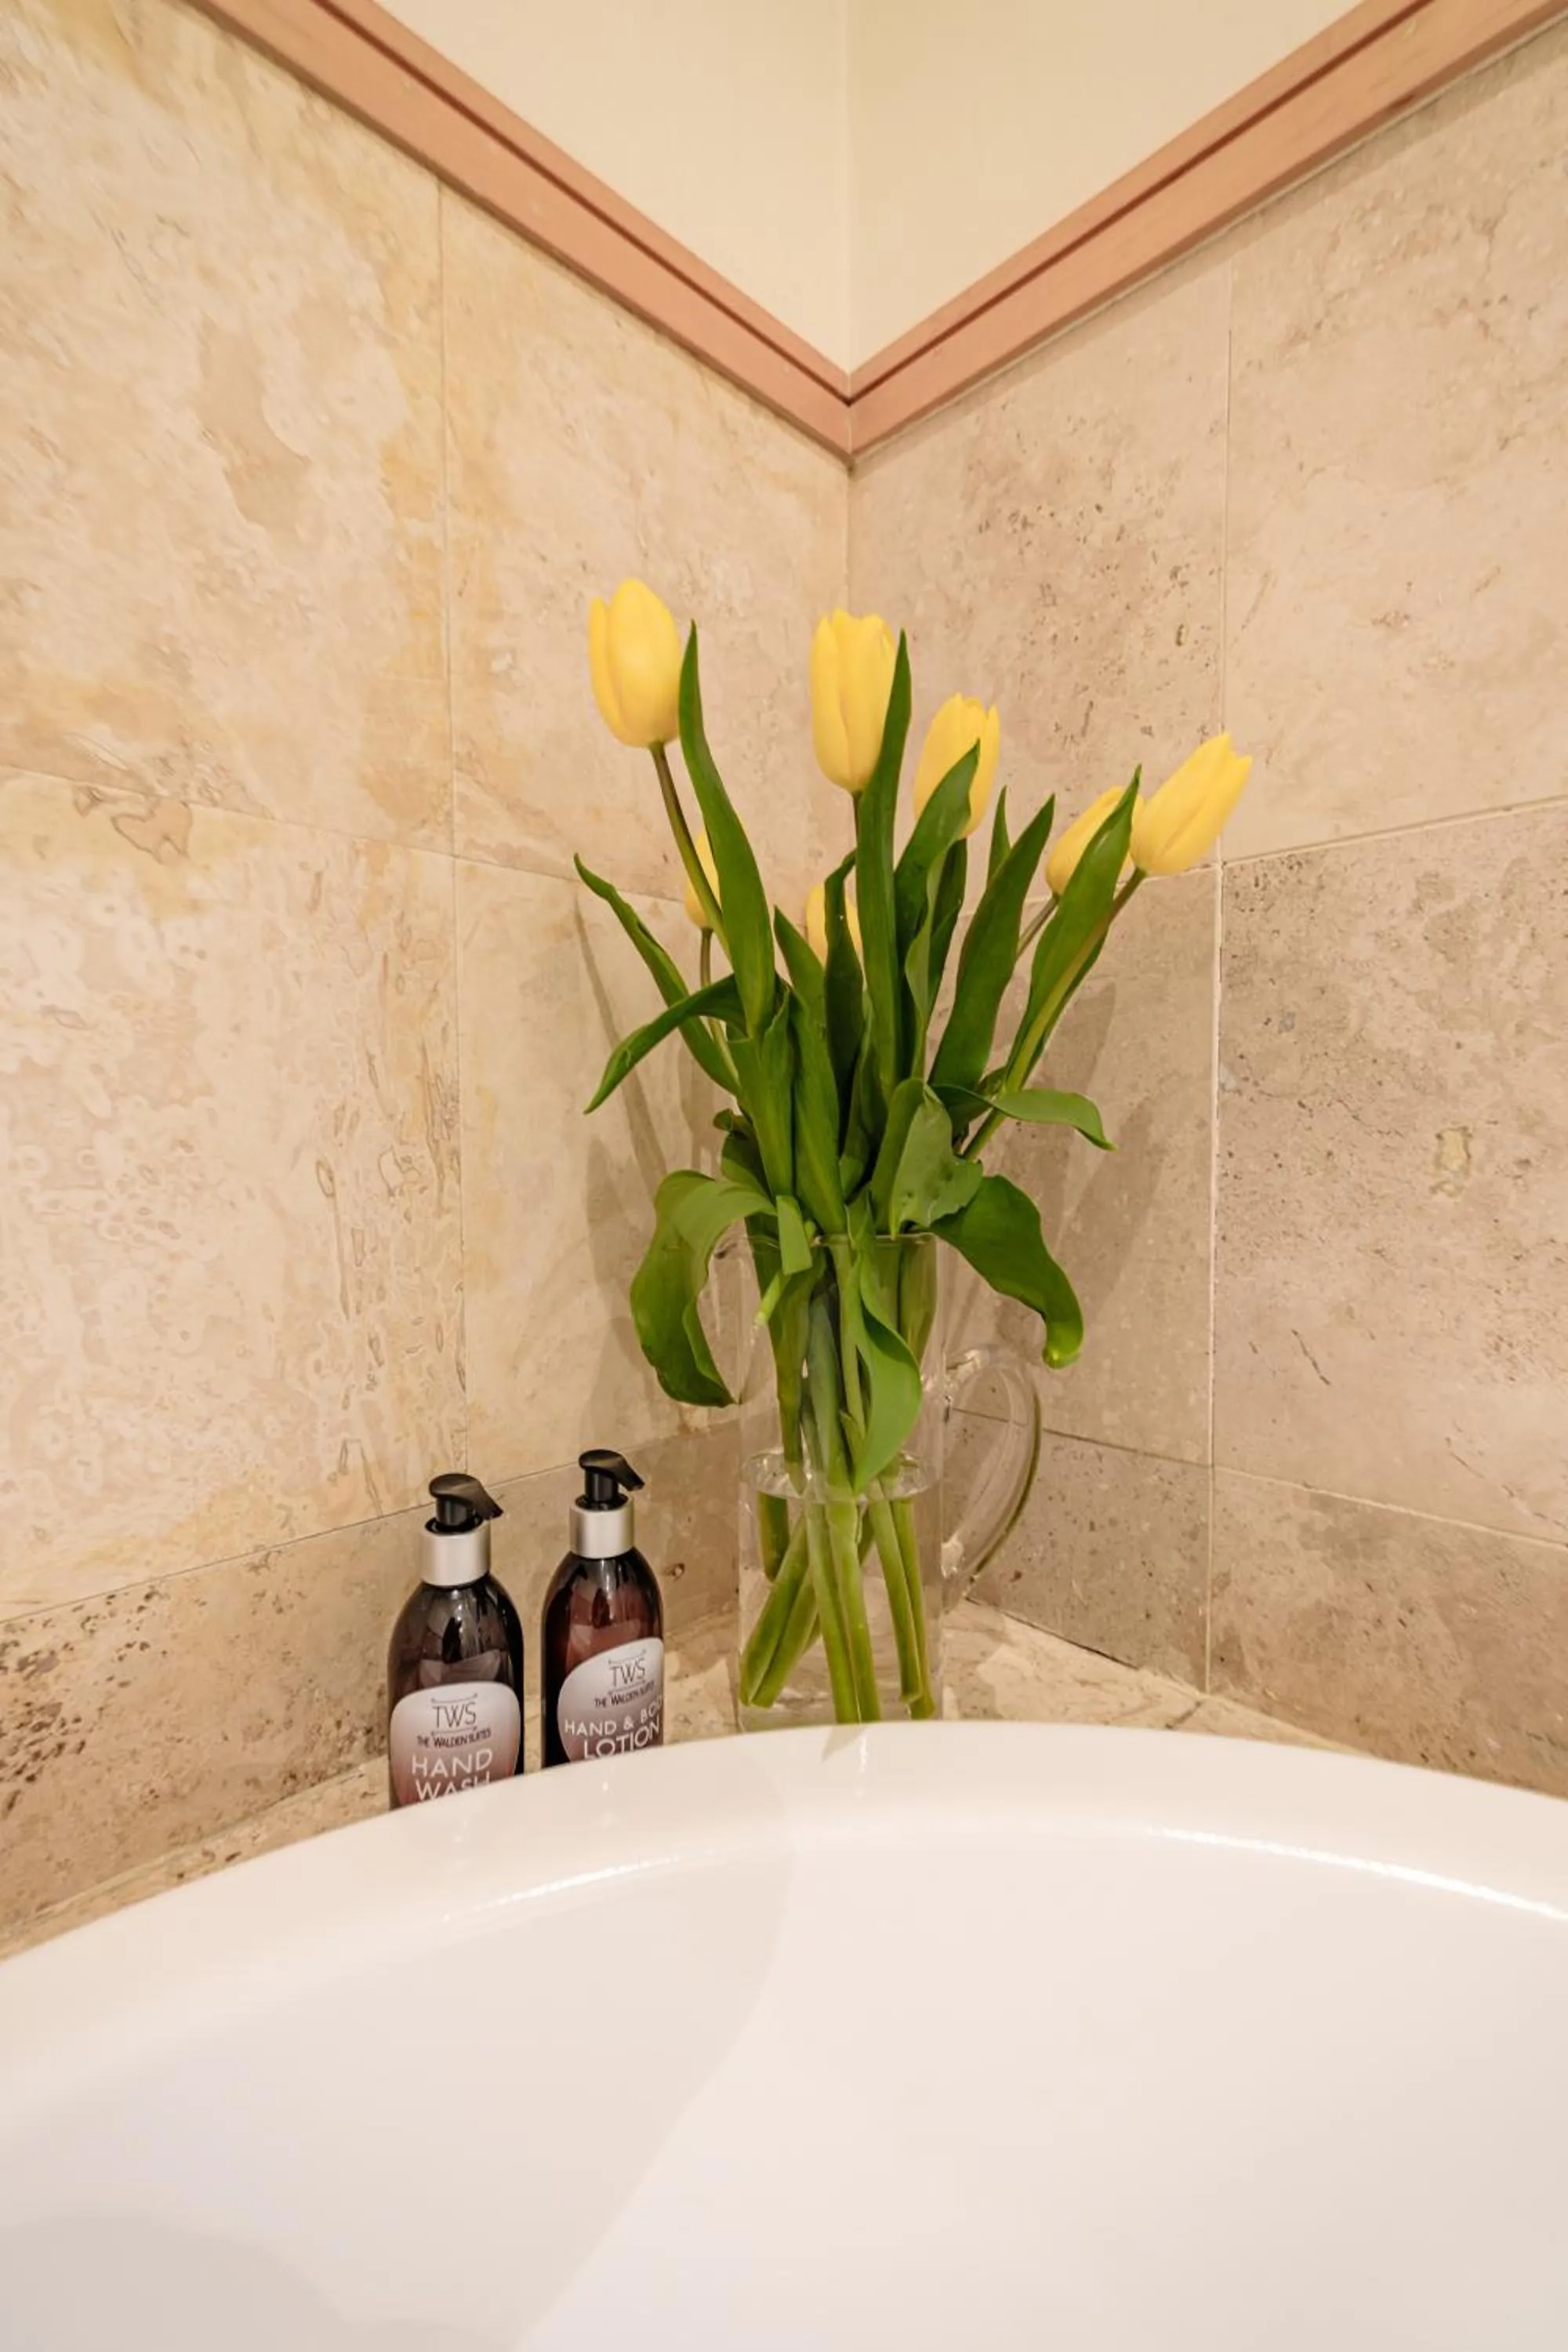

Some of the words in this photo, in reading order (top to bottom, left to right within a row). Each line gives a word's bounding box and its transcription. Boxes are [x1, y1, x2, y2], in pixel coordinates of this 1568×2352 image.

[609, 1657, 645, 1687] TWS
[433, 1701, 477, 1728] TWS
[595, 1697, 607, 1708] THE
[564, 1719, 616, 1736] HAND
[623, 1715, 634, 1730] &
[584, 1715, 659, 1759] LOTION
[417, 1735, 430, 1748] THE
[412, 1748, 492, 1778] HAND
[416, 1771, 490, 1800] WASH
